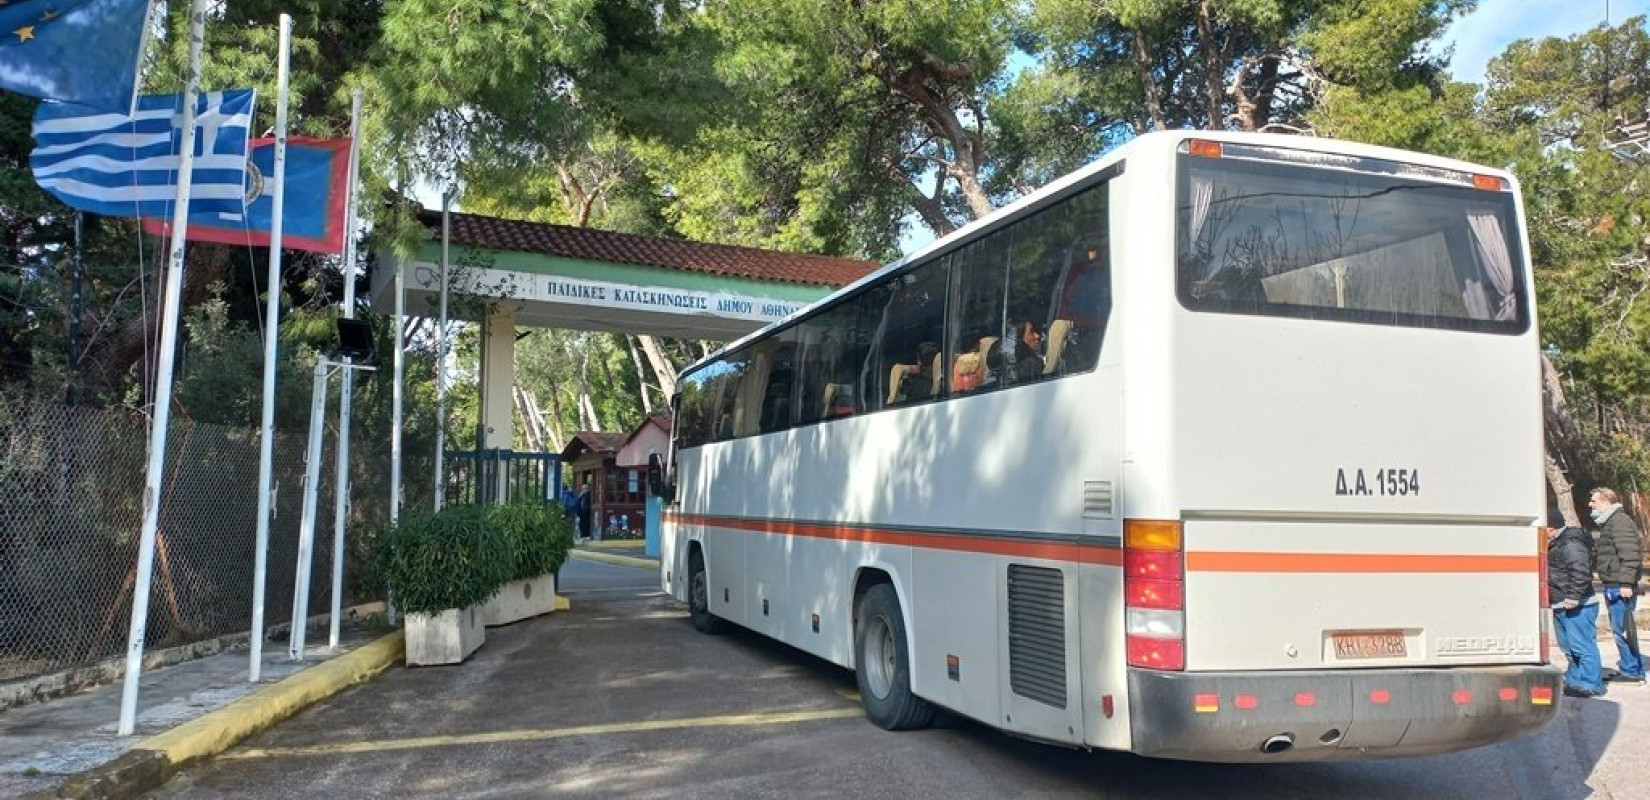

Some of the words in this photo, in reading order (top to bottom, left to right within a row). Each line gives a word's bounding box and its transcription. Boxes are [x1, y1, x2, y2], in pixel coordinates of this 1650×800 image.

[547, 282, 605, 299] ΠΑΙΔΙΚΕΣ
[614, 288, 707, 309] ΚΑΤΑΣΚΗΝΩΣΕΙΣ
[716, 299, 752, 314] ΔΗΜΟΥ
[1376, 467, 1419, 496] 1554
[1436, 636, 1535, 653] NEOPLAN
